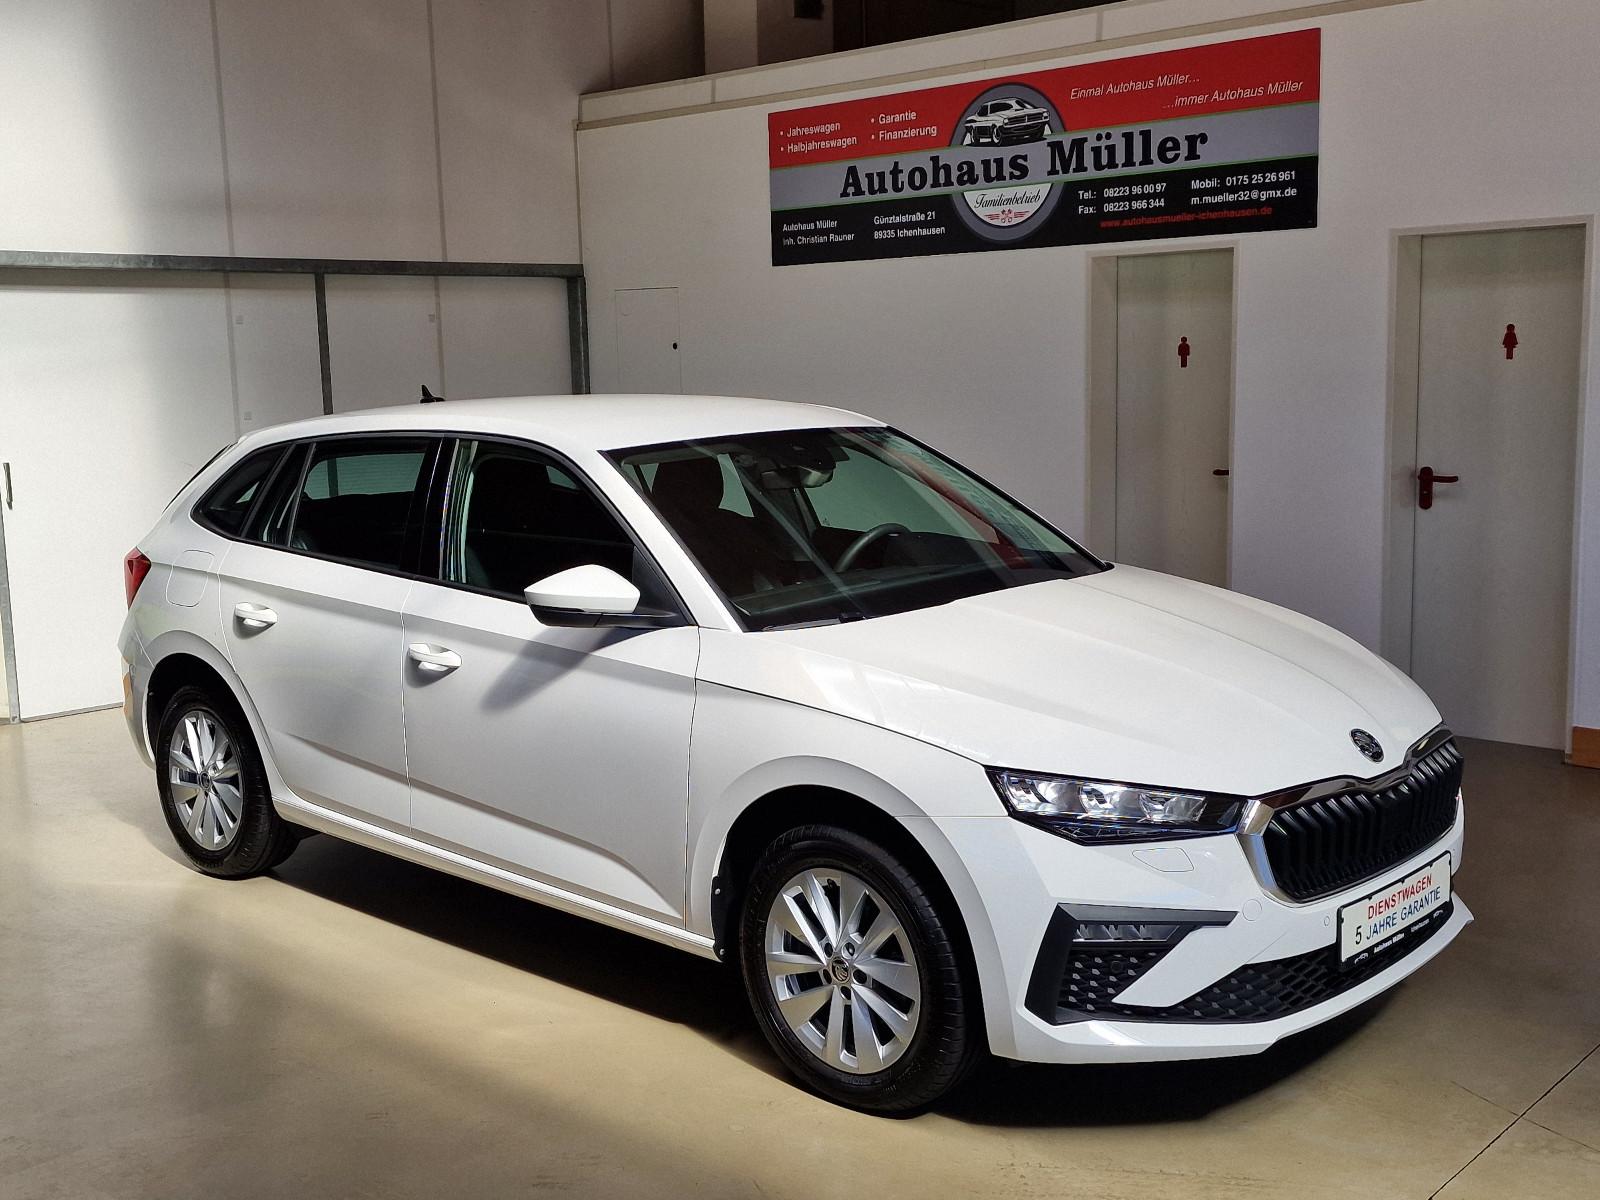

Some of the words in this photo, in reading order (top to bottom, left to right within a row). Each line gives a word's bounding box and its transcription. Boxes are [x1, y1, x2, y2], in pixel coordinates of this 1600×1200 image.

[1070, 83, 1104, 100] Einmal
[1106, 79, 1154, 95] Autohaus
[1211, 86, 1264, 103] Autohaus
[1267, 80, 1303, 95] Müller
[879, 110, 917, 124] Garantie
[787, 122, 841, 138] Jahreswagen
[879, 125, 938, 141] Finanzierung
[787, 136, 857, 153] Halbjahreswagen
[840, 153, 1029, 198] Autohaus
[1046, 129, 1208, 176] Müller
[1191, 178, 1220, 189] Mobil:
[1225, 175, 1249, 186] 0175
[1251, 173, 1264, 184] 25
[1265, 172, 1277, 182] 26
[1278, 170, 1296, 180] 961
[974, 189, 1041, 208] Familienbetrieb
[1078, 190, 1097, 200] Tel.:
[1103, 186, 1130, 198] 08223
[1131, 185, 1142, 194] 96
[1155, 182, 1167, 192] 97
[1191, 187, 1297, 205] m.mueller32@gmx.de
[1078, 205, 1097, 214] Fax:
[1103, 201, 1130, 212] 08223
[1131, 200, 1147, 210] 966
[1148, 198, 1165, 208] 344
[782, 222, 815, 232] Autohaus
[816, 219, 838, 229] Müller
[874, 212, 926, 225] Günztalstraße
[927, 211, 936, 220] 21
[782, 236, 795, 246] Inh.
[797, 235, 828, 245] Christian
[829, 233, 855, 242] Rauner
[874, 229, 896, 239] 89335
[897, 226, 946, 237] Ichenhausen
[1368, 873, 1432, 920] DIENSTWAGEN
[1355, 925, 1362, 945] 5
[1366, 912, 1397, 940] JAHRE
[1400, 886, 1441, 921] GARANTIE
